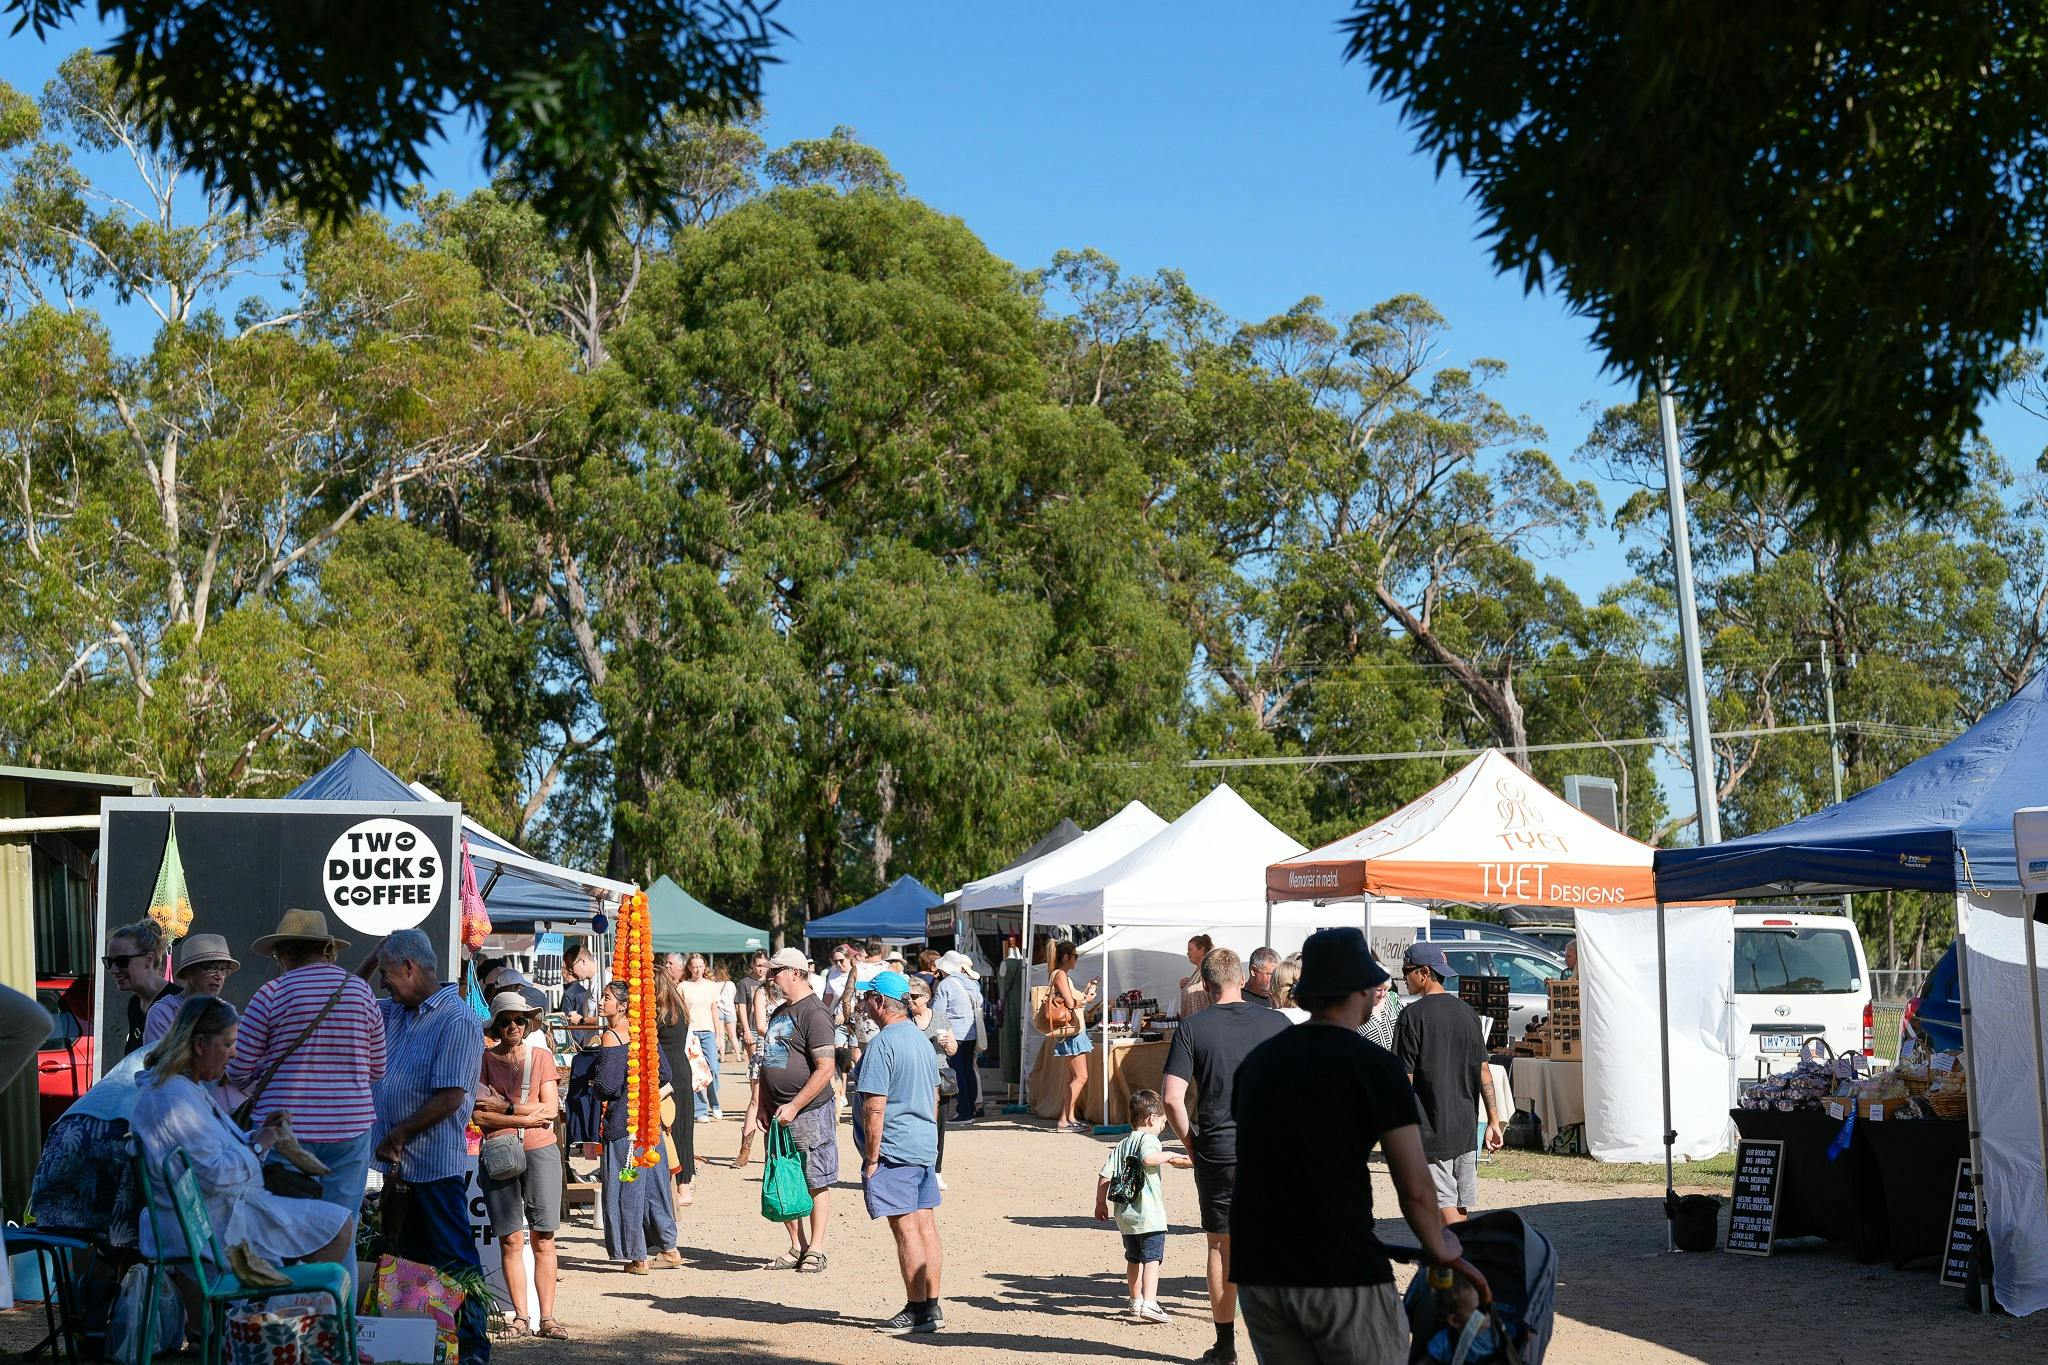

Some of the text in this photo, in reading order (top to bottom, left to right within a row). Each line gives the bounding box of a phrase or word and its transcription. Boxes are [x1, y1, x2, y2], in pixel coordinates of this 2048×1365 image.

[348, 831, 416, 852] TWO
[1496, 831, 1568, 853] TYET
[329, 856, 435, 880] DUCKS
[1289, 870, 1315, 888] Memories
[1478, 863, 1625, 904] TYET DESIGNS
[334, 884, 430, 906] COFFEE
